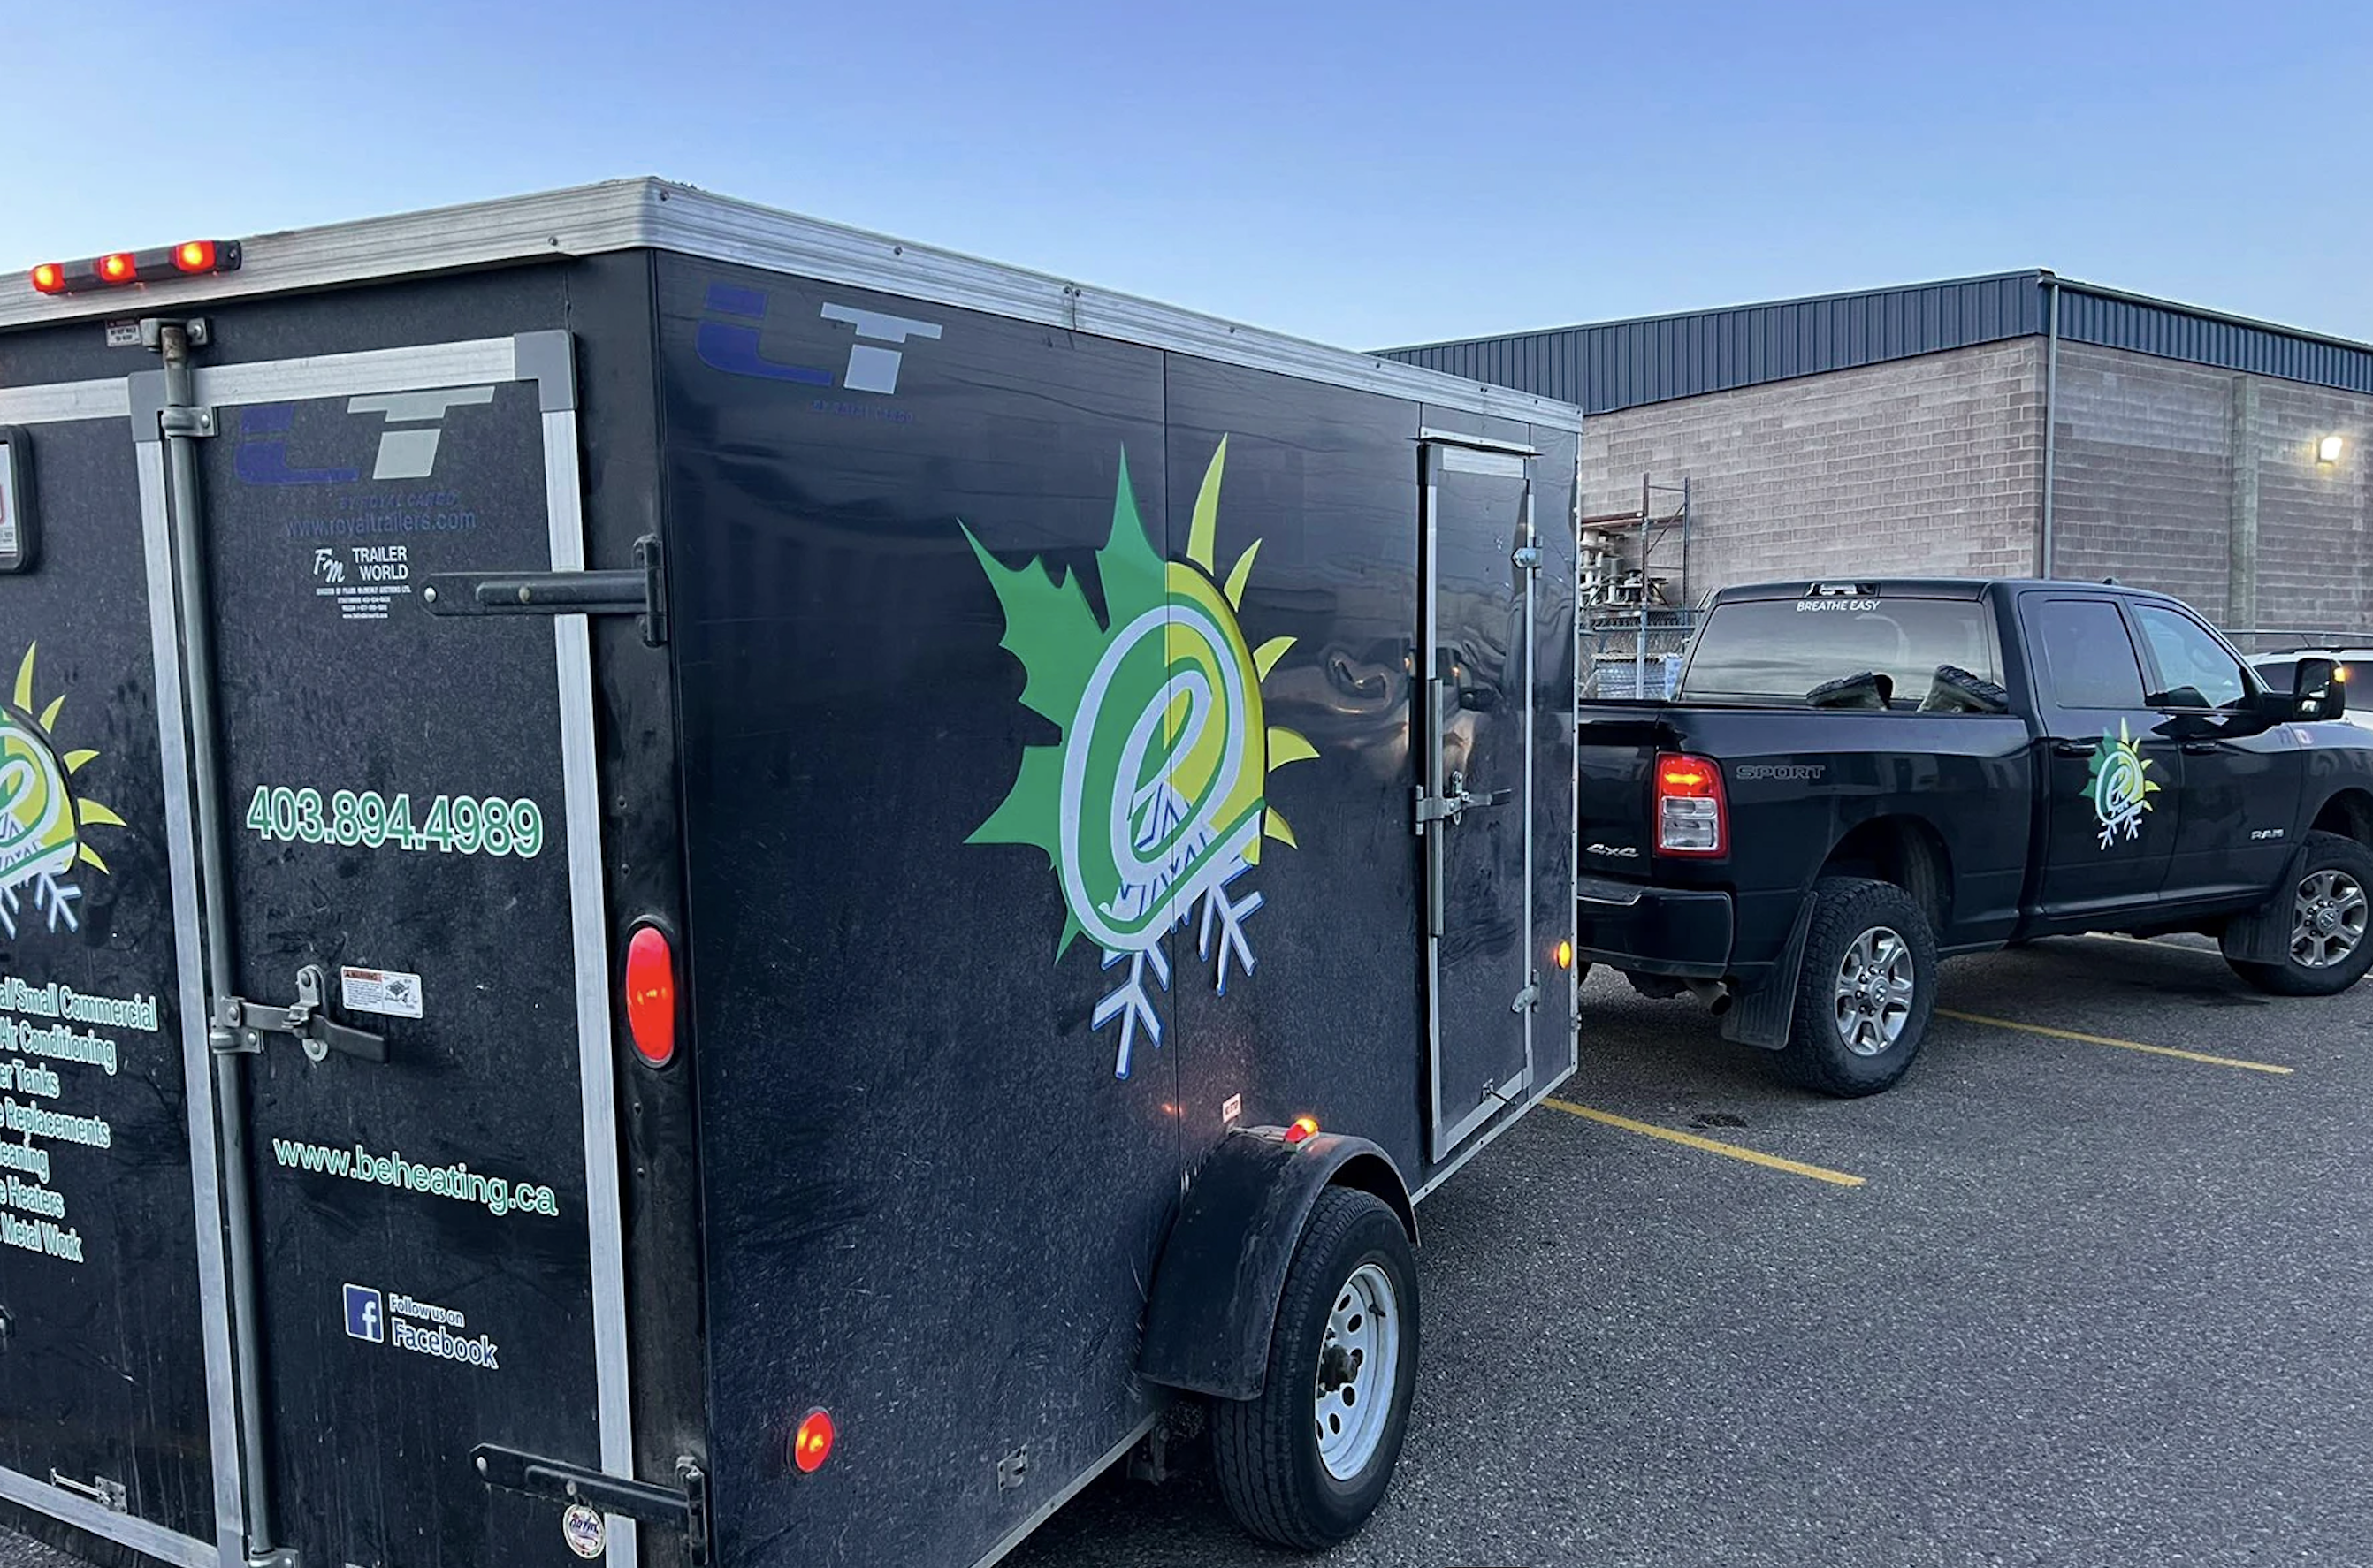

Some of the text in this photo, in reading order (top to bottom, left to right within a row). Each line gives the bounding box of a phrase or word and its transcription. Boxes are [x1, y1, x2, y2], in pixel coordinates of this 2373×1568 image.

[286, 510, 477, 537] www.royaltrailers.com
[352, 545, 408, 564] TRAILER
[359, 564, 408, 582] WORLD
[1796, 600, 1881, 613] BREATHE EASY
[1736, 765, 1826, 780] SPORT
[247, 785, 543, 858] 403.894.4989
[2250, 828, 2284, 840] RAM
[59, 985, 159, 1032] Commercial
[19, 1019, 118, 1077] Conditioning
[11, 1058, 60, 1099] Tanks
[4, 1096, 111, 1149] Replacements
[6, 1174, 65, 1219] Heaters
[272, 1138, 559, 1216] www.beheating.ca
[1, 1211, 84, 1263] Metal Work
[388, 1292, 465, 1328] Follow us on
[391, 1316, 500, 1370] Facebook
